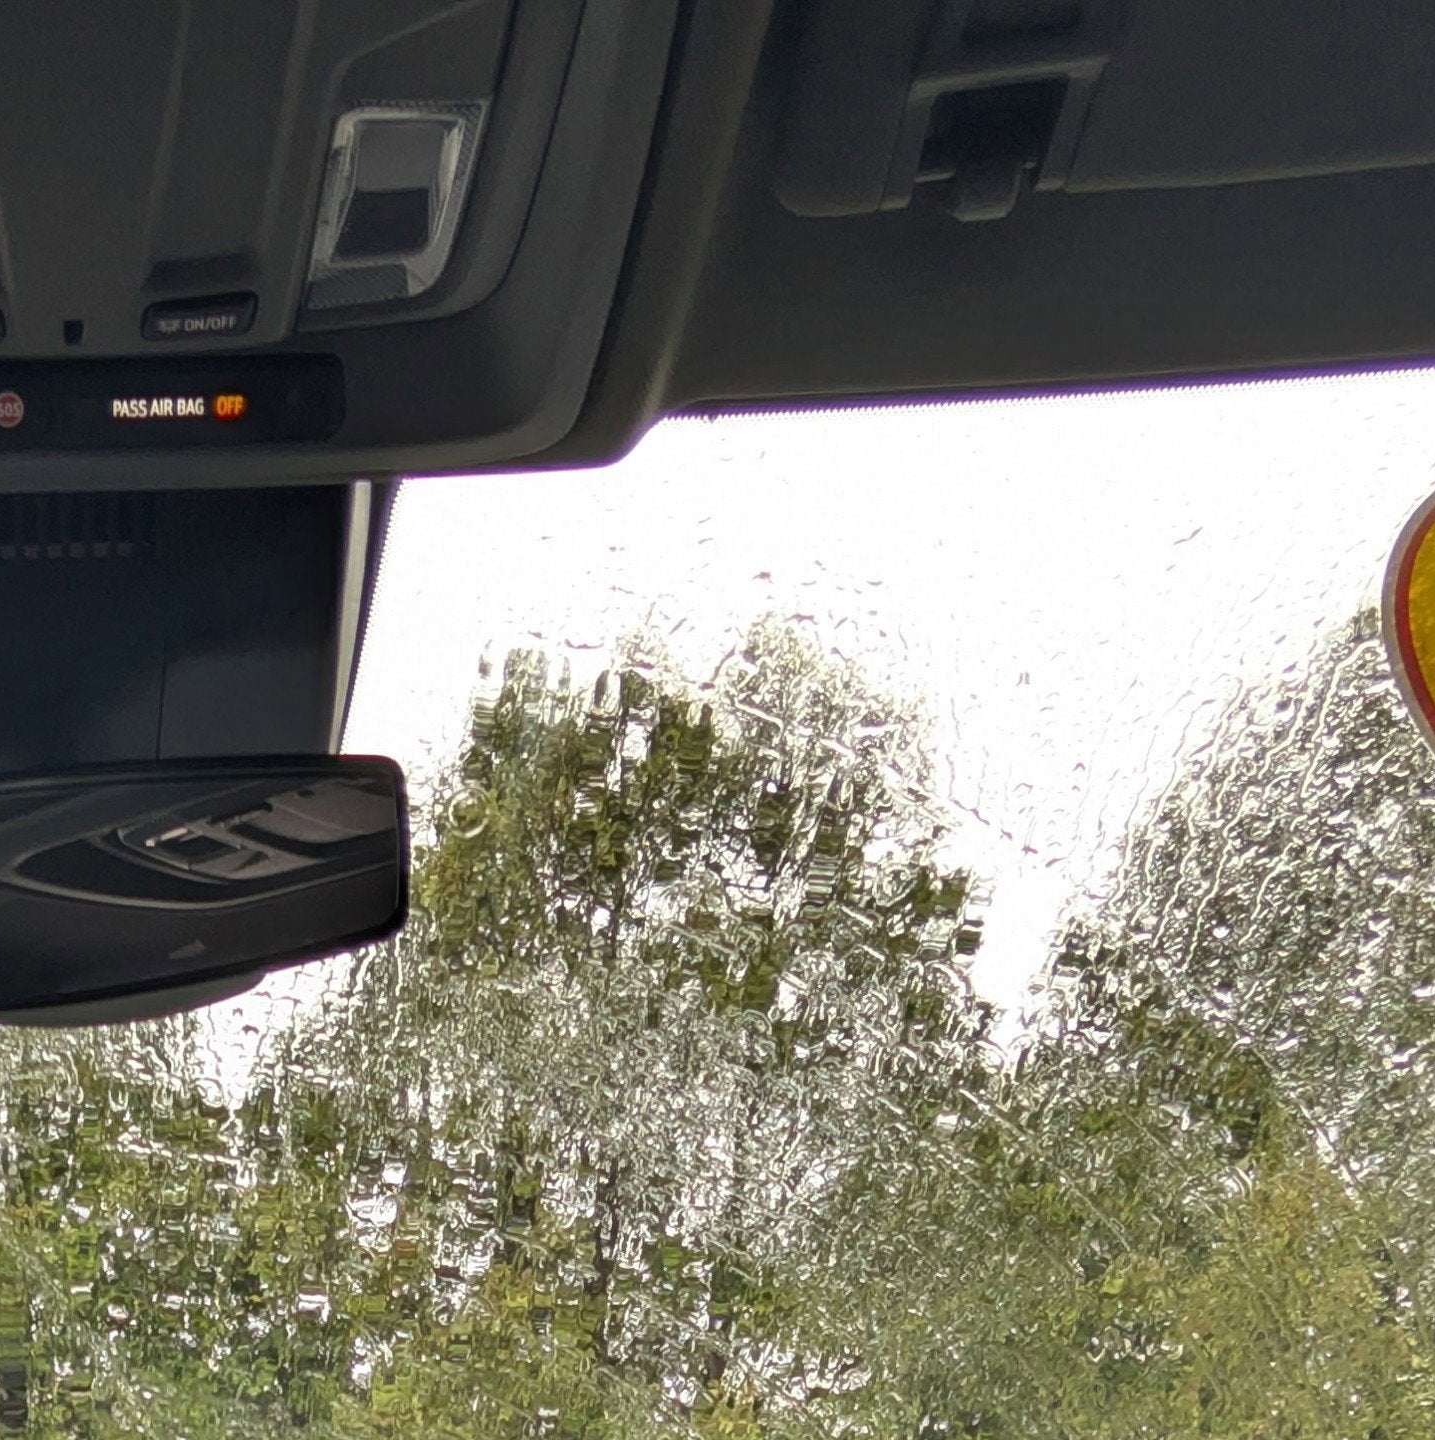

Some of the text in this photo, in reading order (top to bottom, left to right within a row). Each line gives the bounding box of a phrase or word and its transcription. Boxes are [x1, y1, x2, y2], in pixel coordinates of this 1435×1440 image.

[183, 315, 237, 332] ON/OFF
[112, 394, 245, 418] PASS AIR BAG OFF
